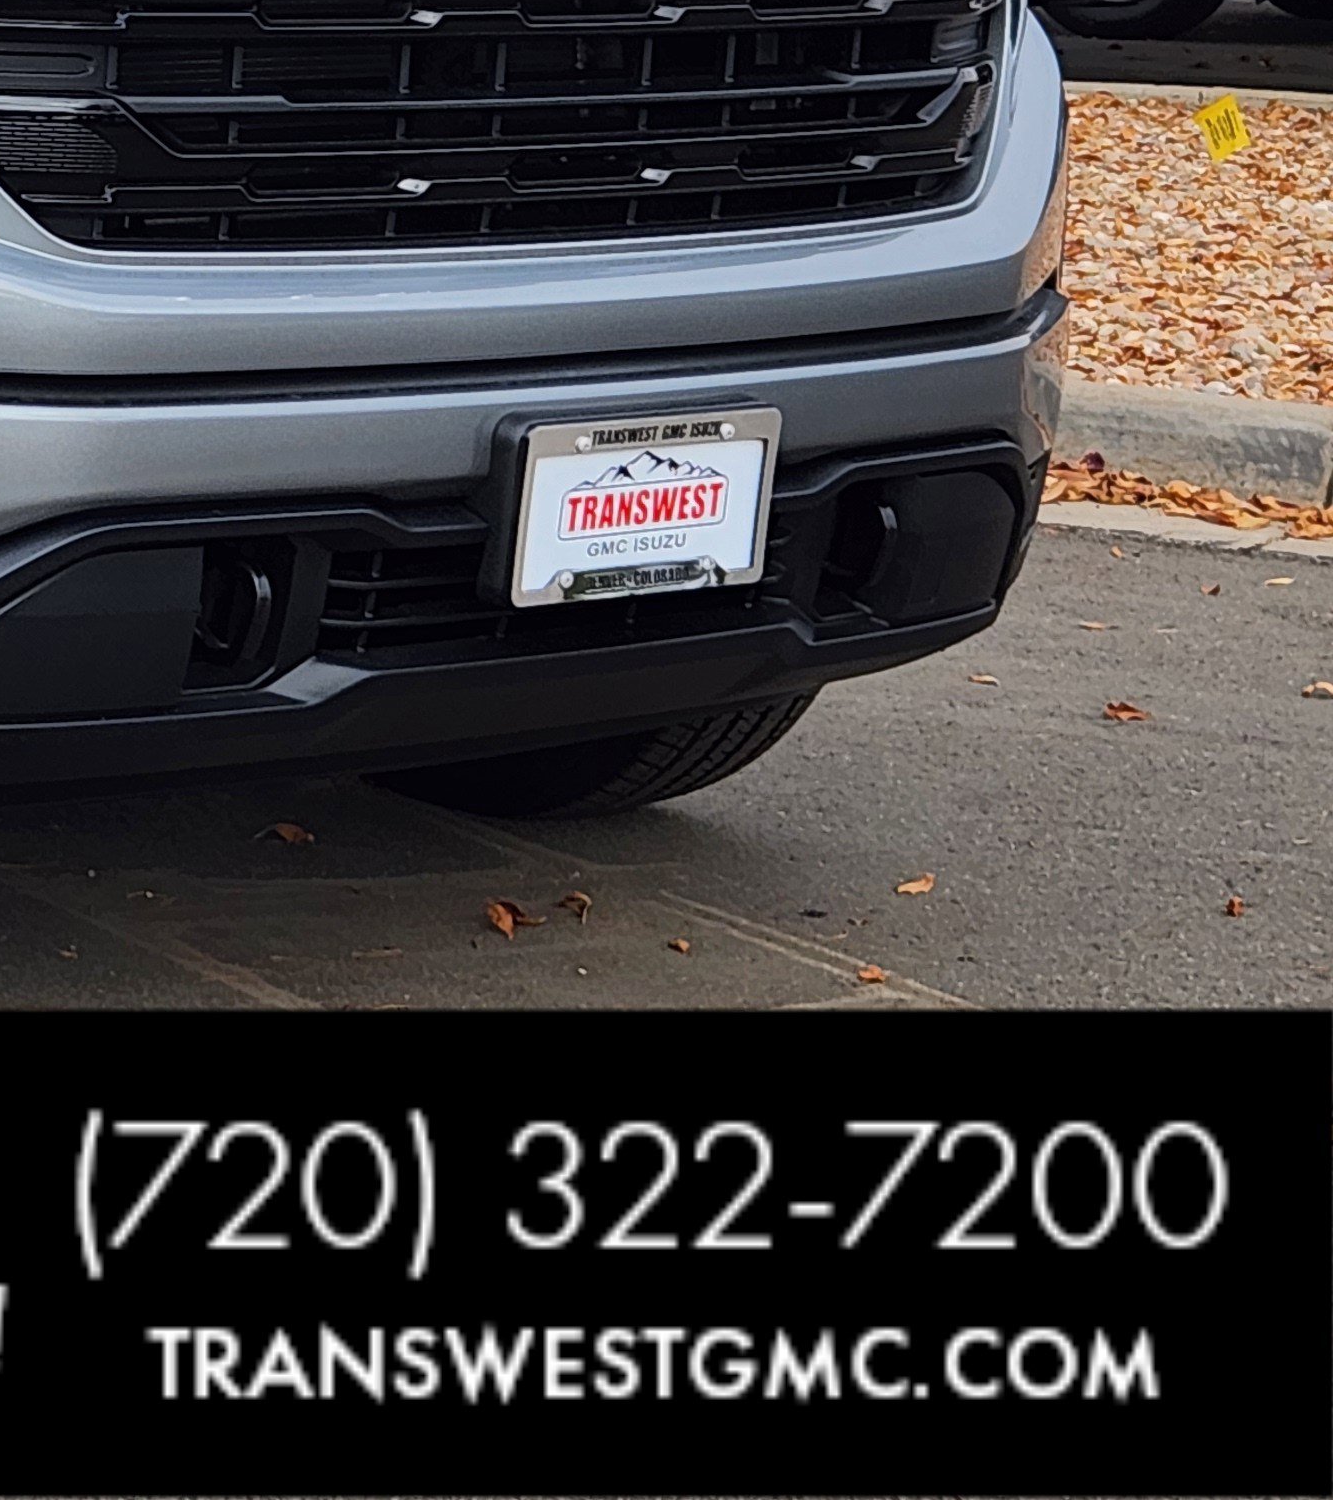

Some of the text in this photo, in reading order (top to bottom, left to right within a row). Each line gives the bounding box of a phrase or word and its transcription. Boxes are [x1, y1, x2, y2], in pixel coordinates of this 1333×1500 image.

[591, 425, 660, 447] TRANSWEST
[661, 422, 688, 440] GMC
[567, 482, 724, 532] TRANSWEST
[586, 532, 687, 558] GMC ISUZU
